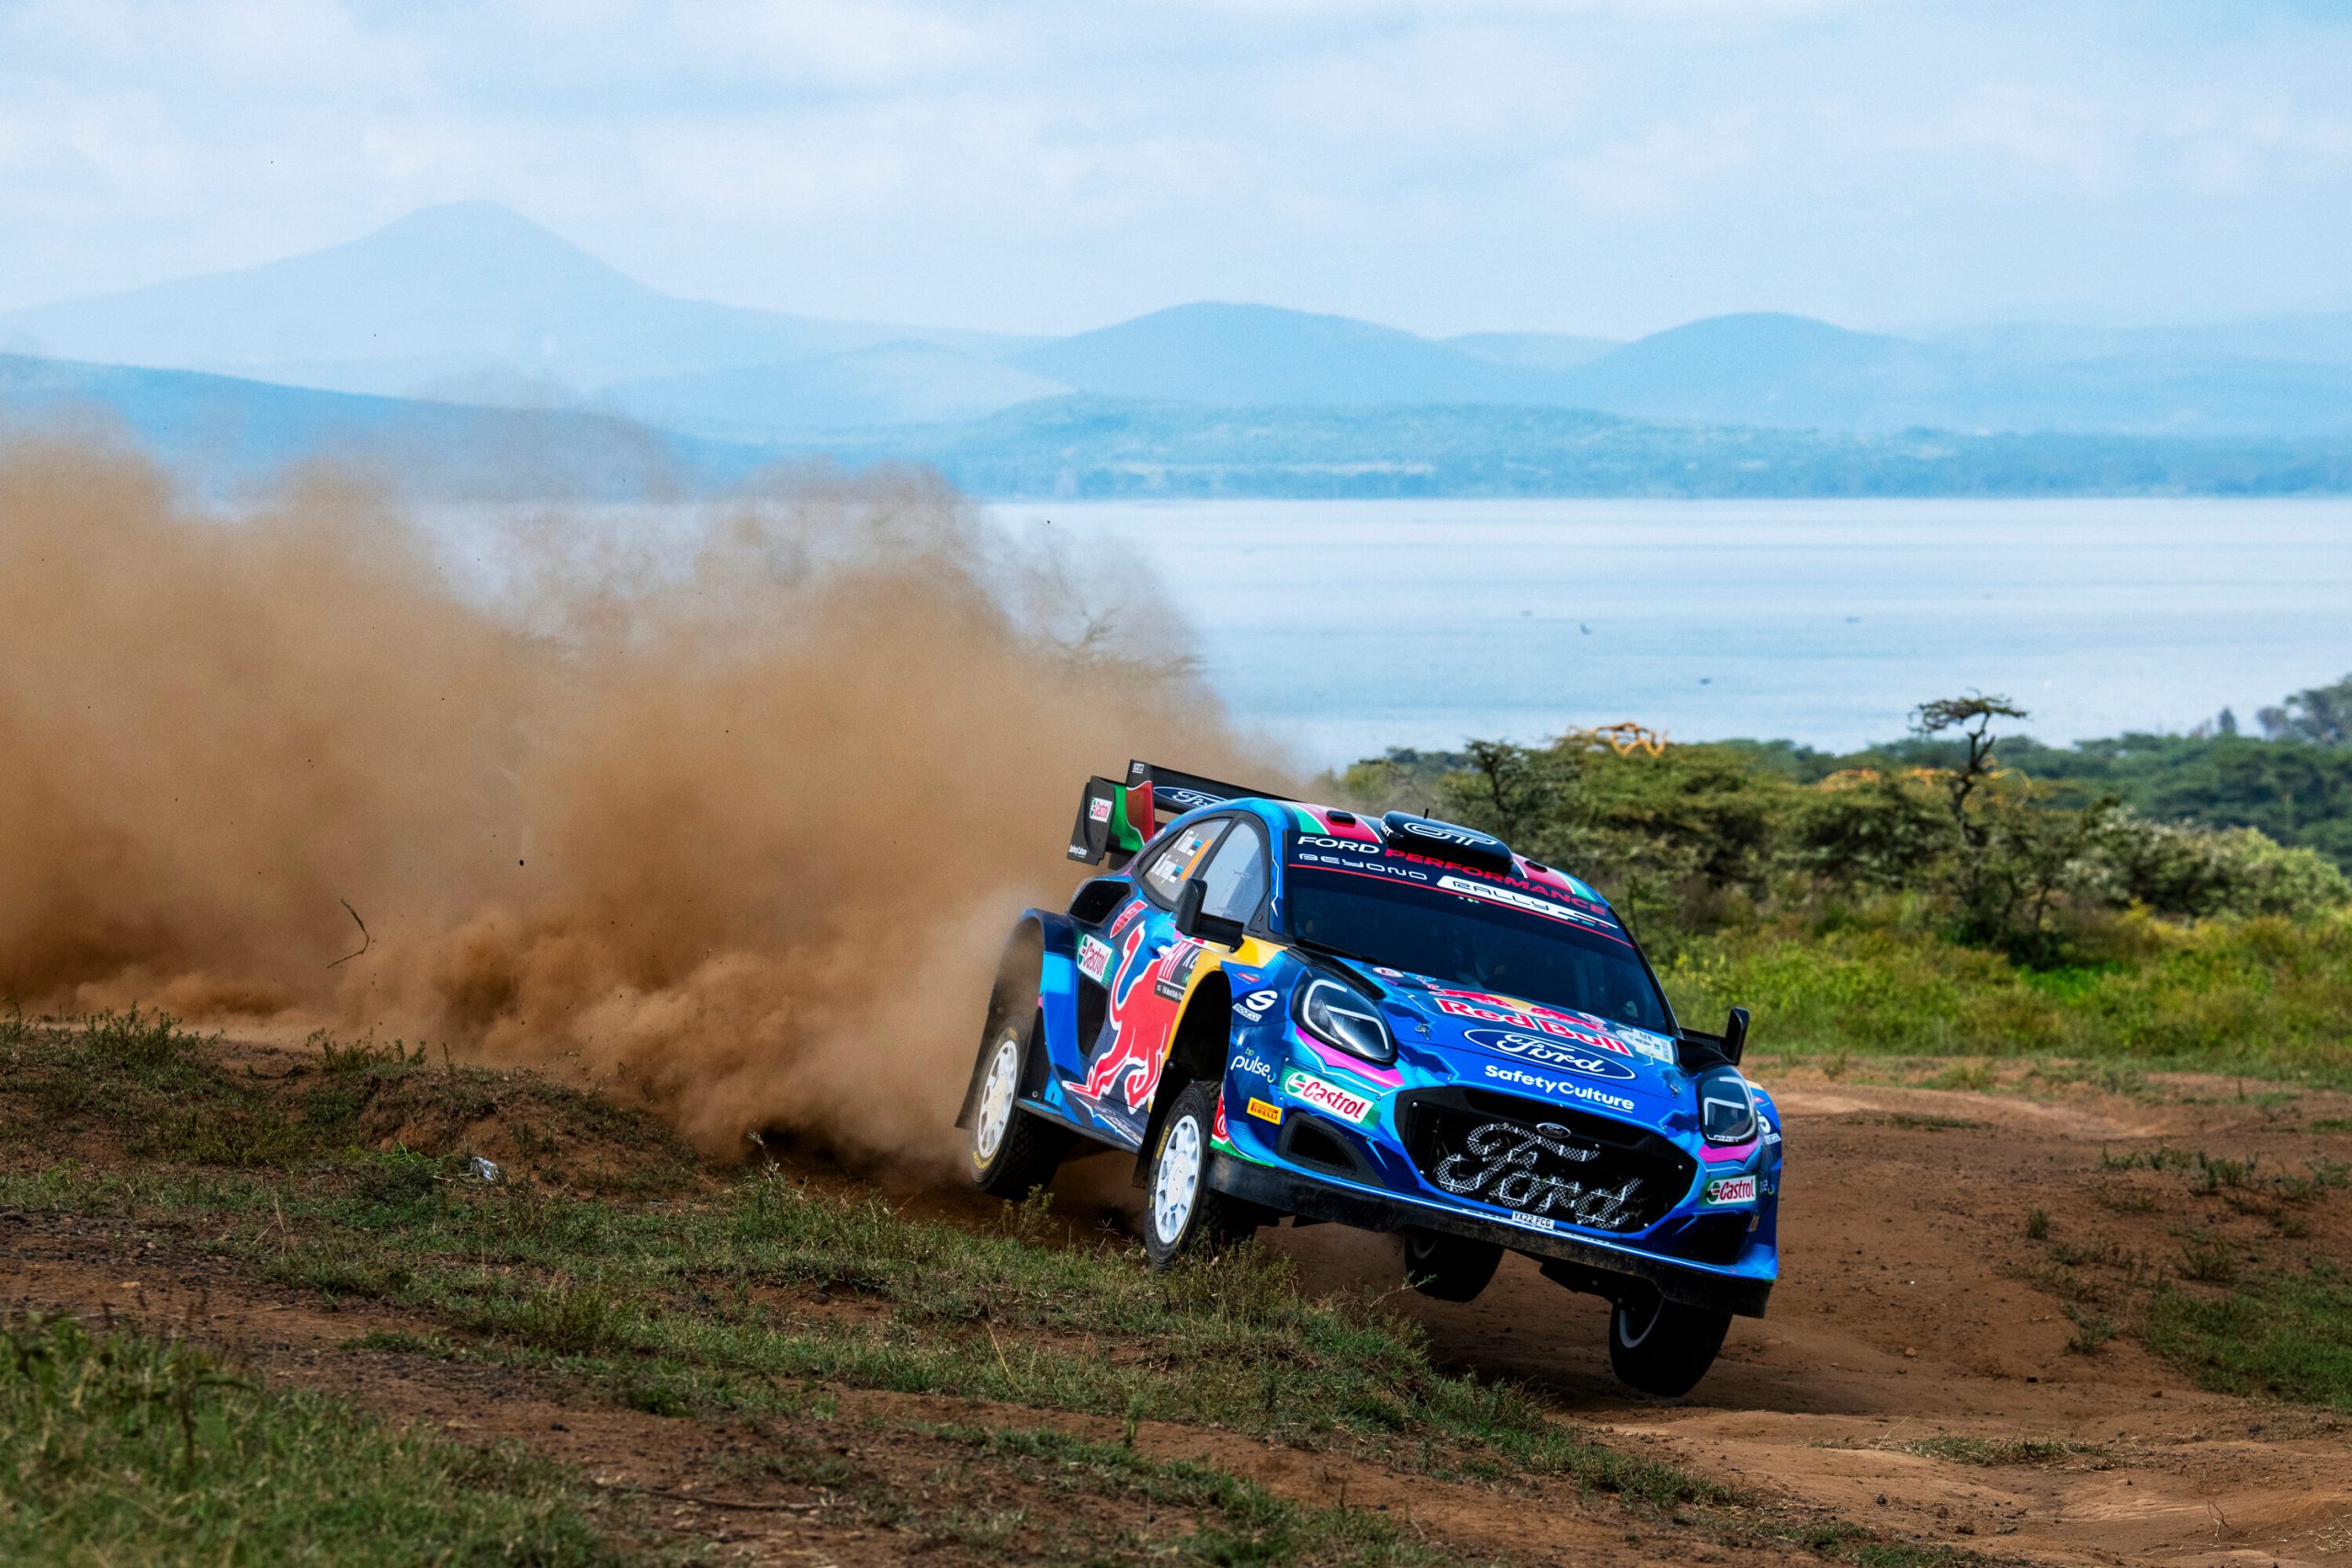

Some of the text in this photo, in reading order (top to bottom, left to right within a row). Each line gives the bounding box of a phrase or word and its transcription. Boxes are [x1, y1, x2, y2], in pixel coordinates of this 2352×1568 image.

[1297, 836, 1606, 916] FORD PERFORMANCE
[1299, 853, 1549, 910] BEYOND RALLY
[1083, 942, 1108, 976] Castrol
[1434, 998, 1539, 1031] Red
[1535, 1018, 1634, 1057] Bull
[1230, 1055, 1270, 1077] pulse
[1245, 1046, 1254, 1056] bp
[1497, 1034, 1605, 1073] Ford
[1303, 1081, 1365, 1119] Castrol
[1485, 1065, 1634, 1110] SafetyCulture
[1250, 1102, 1279, 1121] PIRELLI
[1437, 1122, 1643, 1230] Ford
[1720, 1179, 1755, 1201] Castrol
[1514, 1212, 1533, 1223] YX22
